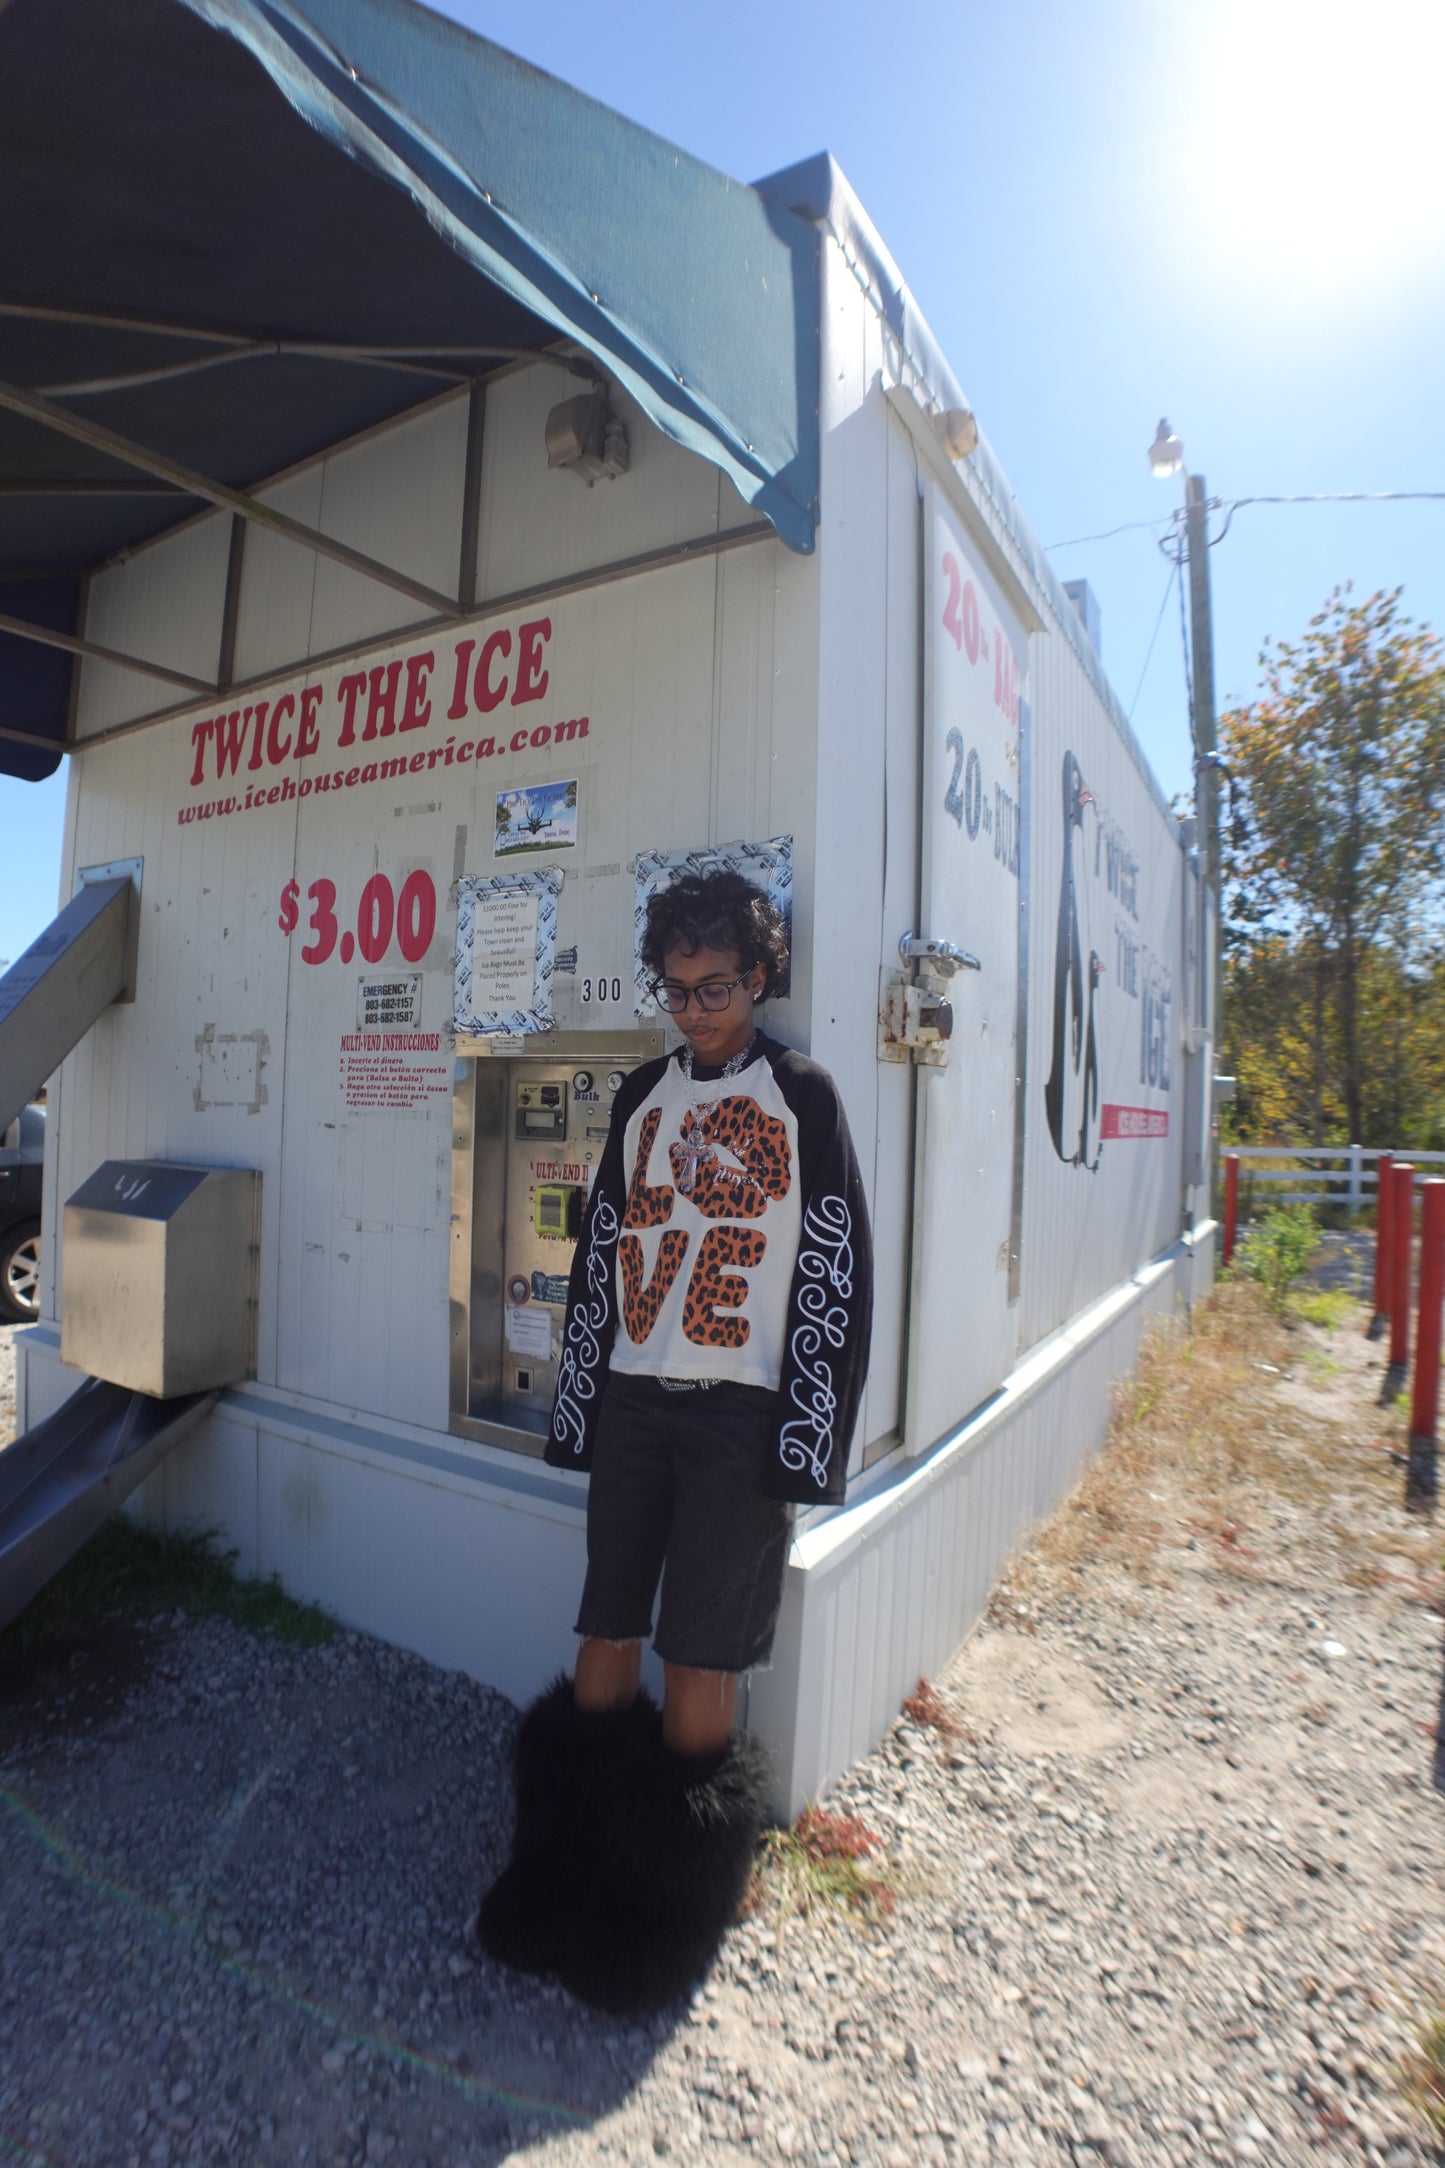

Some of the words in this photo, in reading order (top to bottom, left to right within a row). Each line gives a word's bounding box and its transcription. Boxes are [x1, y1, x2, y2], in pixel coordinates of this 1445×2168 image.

[942, 551, 979, 666] 20
[190, 684, 323, 786] TWICE
[337, 650, 435, 748] THE
[447, 617, 552, 720] ICE
[177, 716, 590, 825] www.icehouseamerica.com
[944, 726, 981, 841] 20
[279, 869, 436, 965] $3.00
[363, 983, 408, 998] EMERGENCY
[410, 984, 418, 994] #
[365, 997, 414, 1011] 803-682-1157
[364, 1011, 414, 1025] 803-682-1587
[340, 1034, 381, 1052] MULTI-VEND
[382, 1033, 439, 1052] INSTRUCCIONES
[381, 1056, 403, 1064] dinero
[573, 1090, 600, 1101] Bulk
